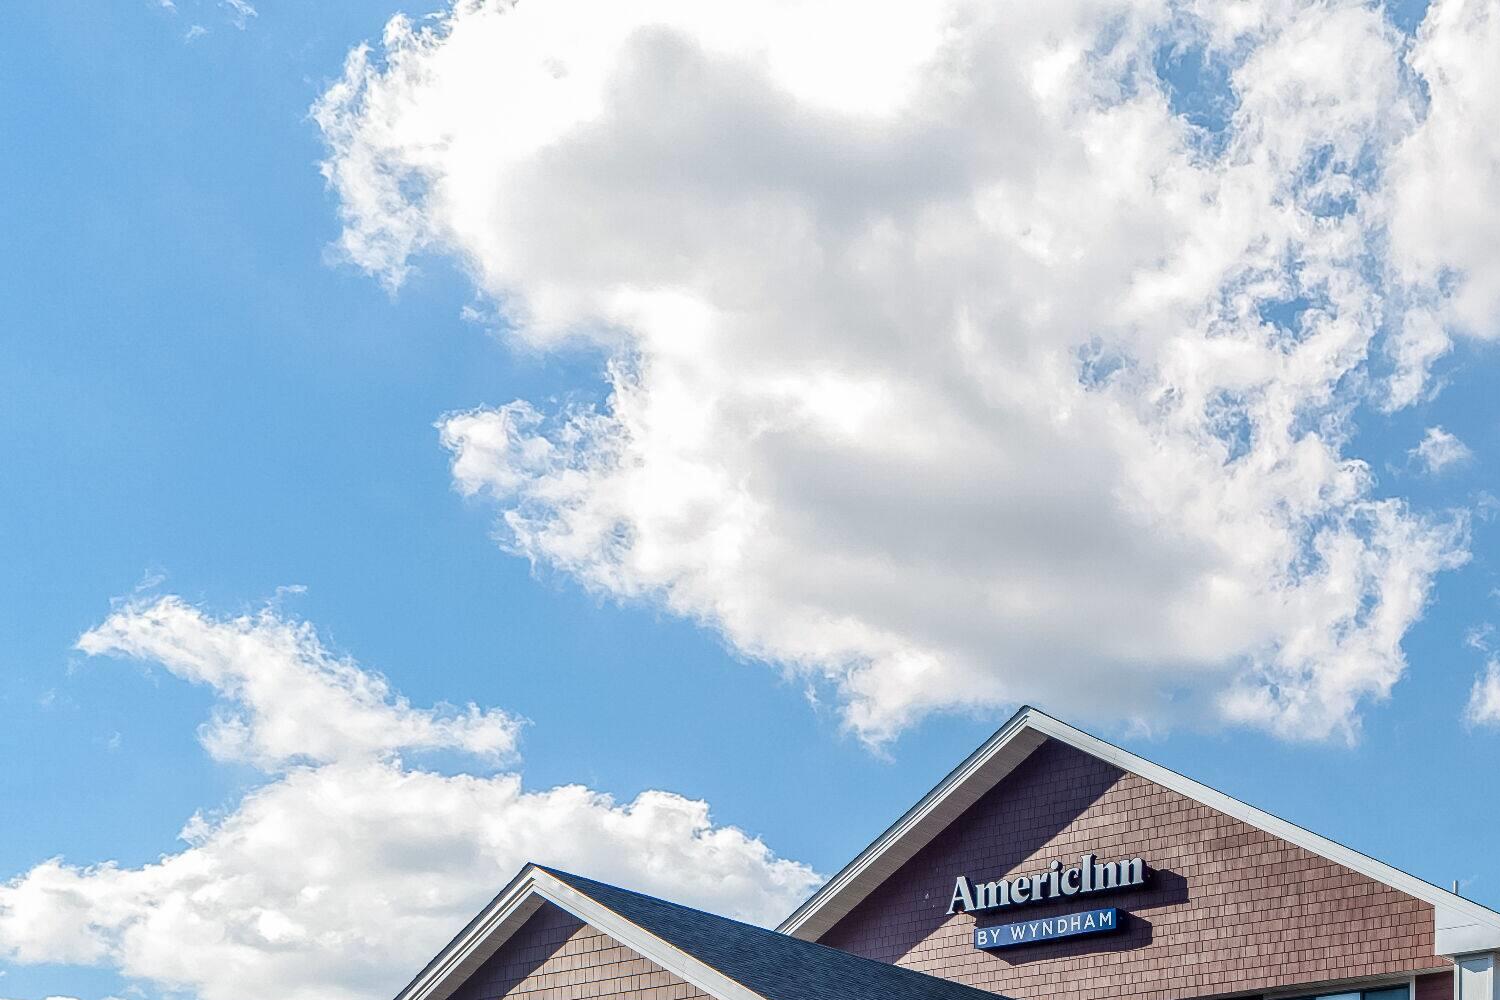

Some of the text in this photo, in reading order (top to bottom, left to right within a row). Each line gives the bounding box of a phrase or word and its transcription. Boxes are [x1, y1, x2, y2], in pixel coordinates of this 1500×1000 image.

[945, 853, 1145, 915] AmericInn
[977, 911, 1113, 946] BY WYNDHAM
